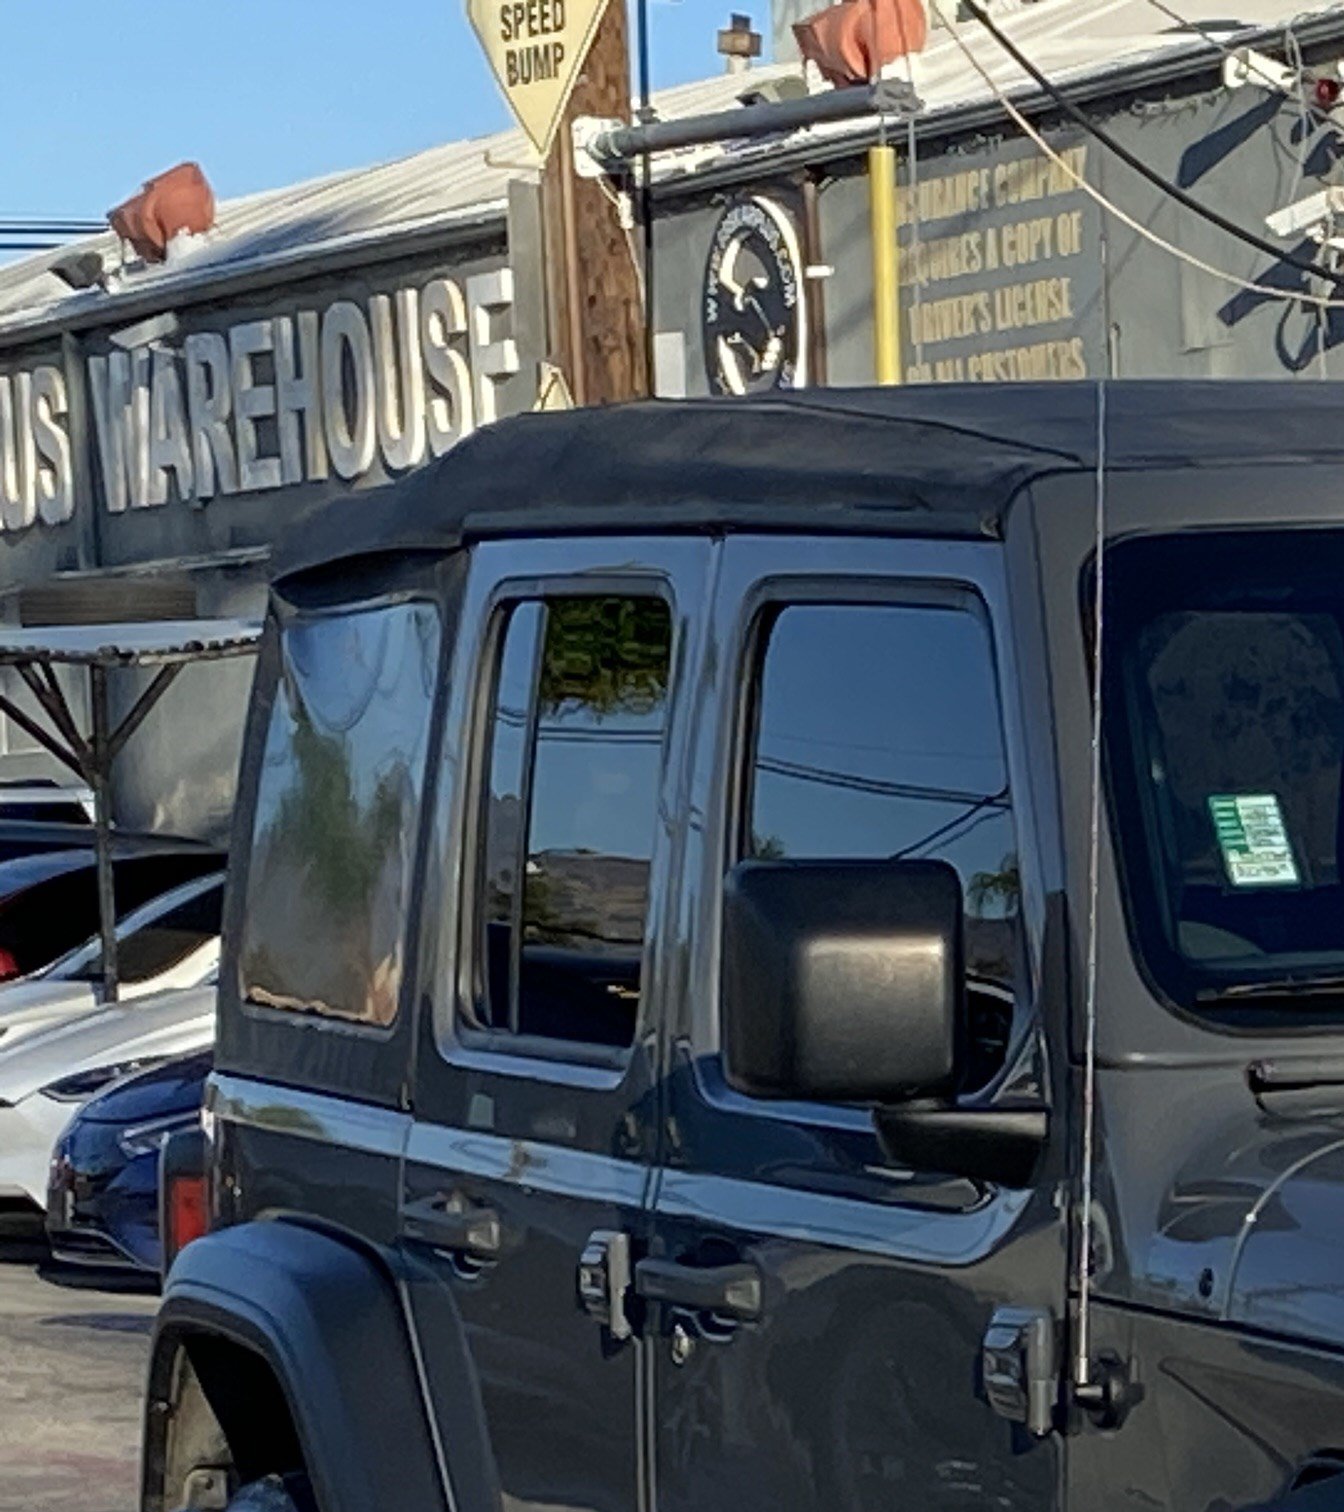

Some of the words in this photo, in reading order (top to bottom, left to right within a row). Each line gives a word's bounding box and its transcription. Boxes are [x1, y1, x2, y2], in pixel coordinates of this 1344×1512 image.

[500, 0, 567, 42] SPEED
[506, 42, 565, 87] BUMP
[985, 227, 999, 270] A
[1002, 217, 1053, 267] COPY
[1056, 209, 1082, 257] OF
[995, 277, 1075, 331] LICENSE
[87, 267, 520, 513] WAREHOUSE
